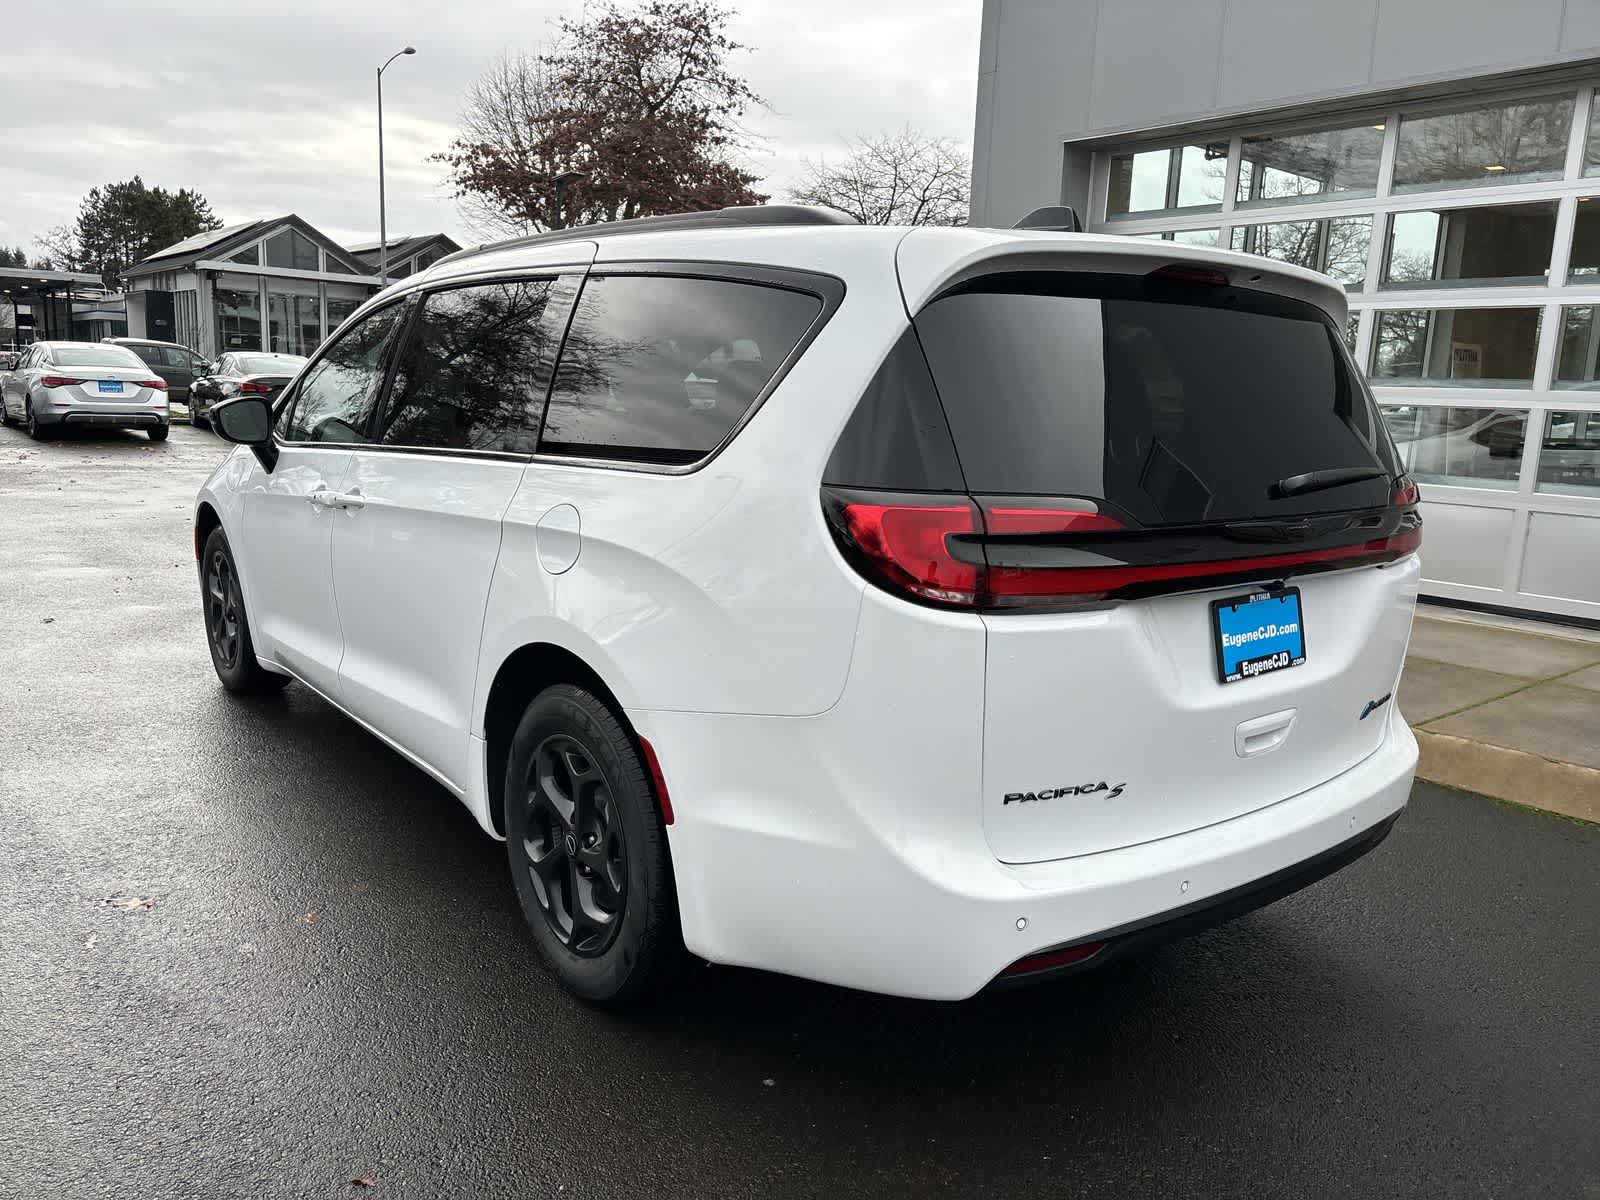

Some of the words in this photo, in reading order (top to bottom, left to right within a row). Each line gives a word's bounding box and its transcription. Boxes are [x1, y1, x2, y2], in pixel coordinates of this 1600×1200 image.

[1222, 623, 1298, 647] EugeneCJD.com
[1226, 673, 1242, 683] www.
[1242, 652, 1289, 676] EugeneCJD
[1003, 781, 1109, 805] PACIFICA
[1104, 782, 1127, 800] S
